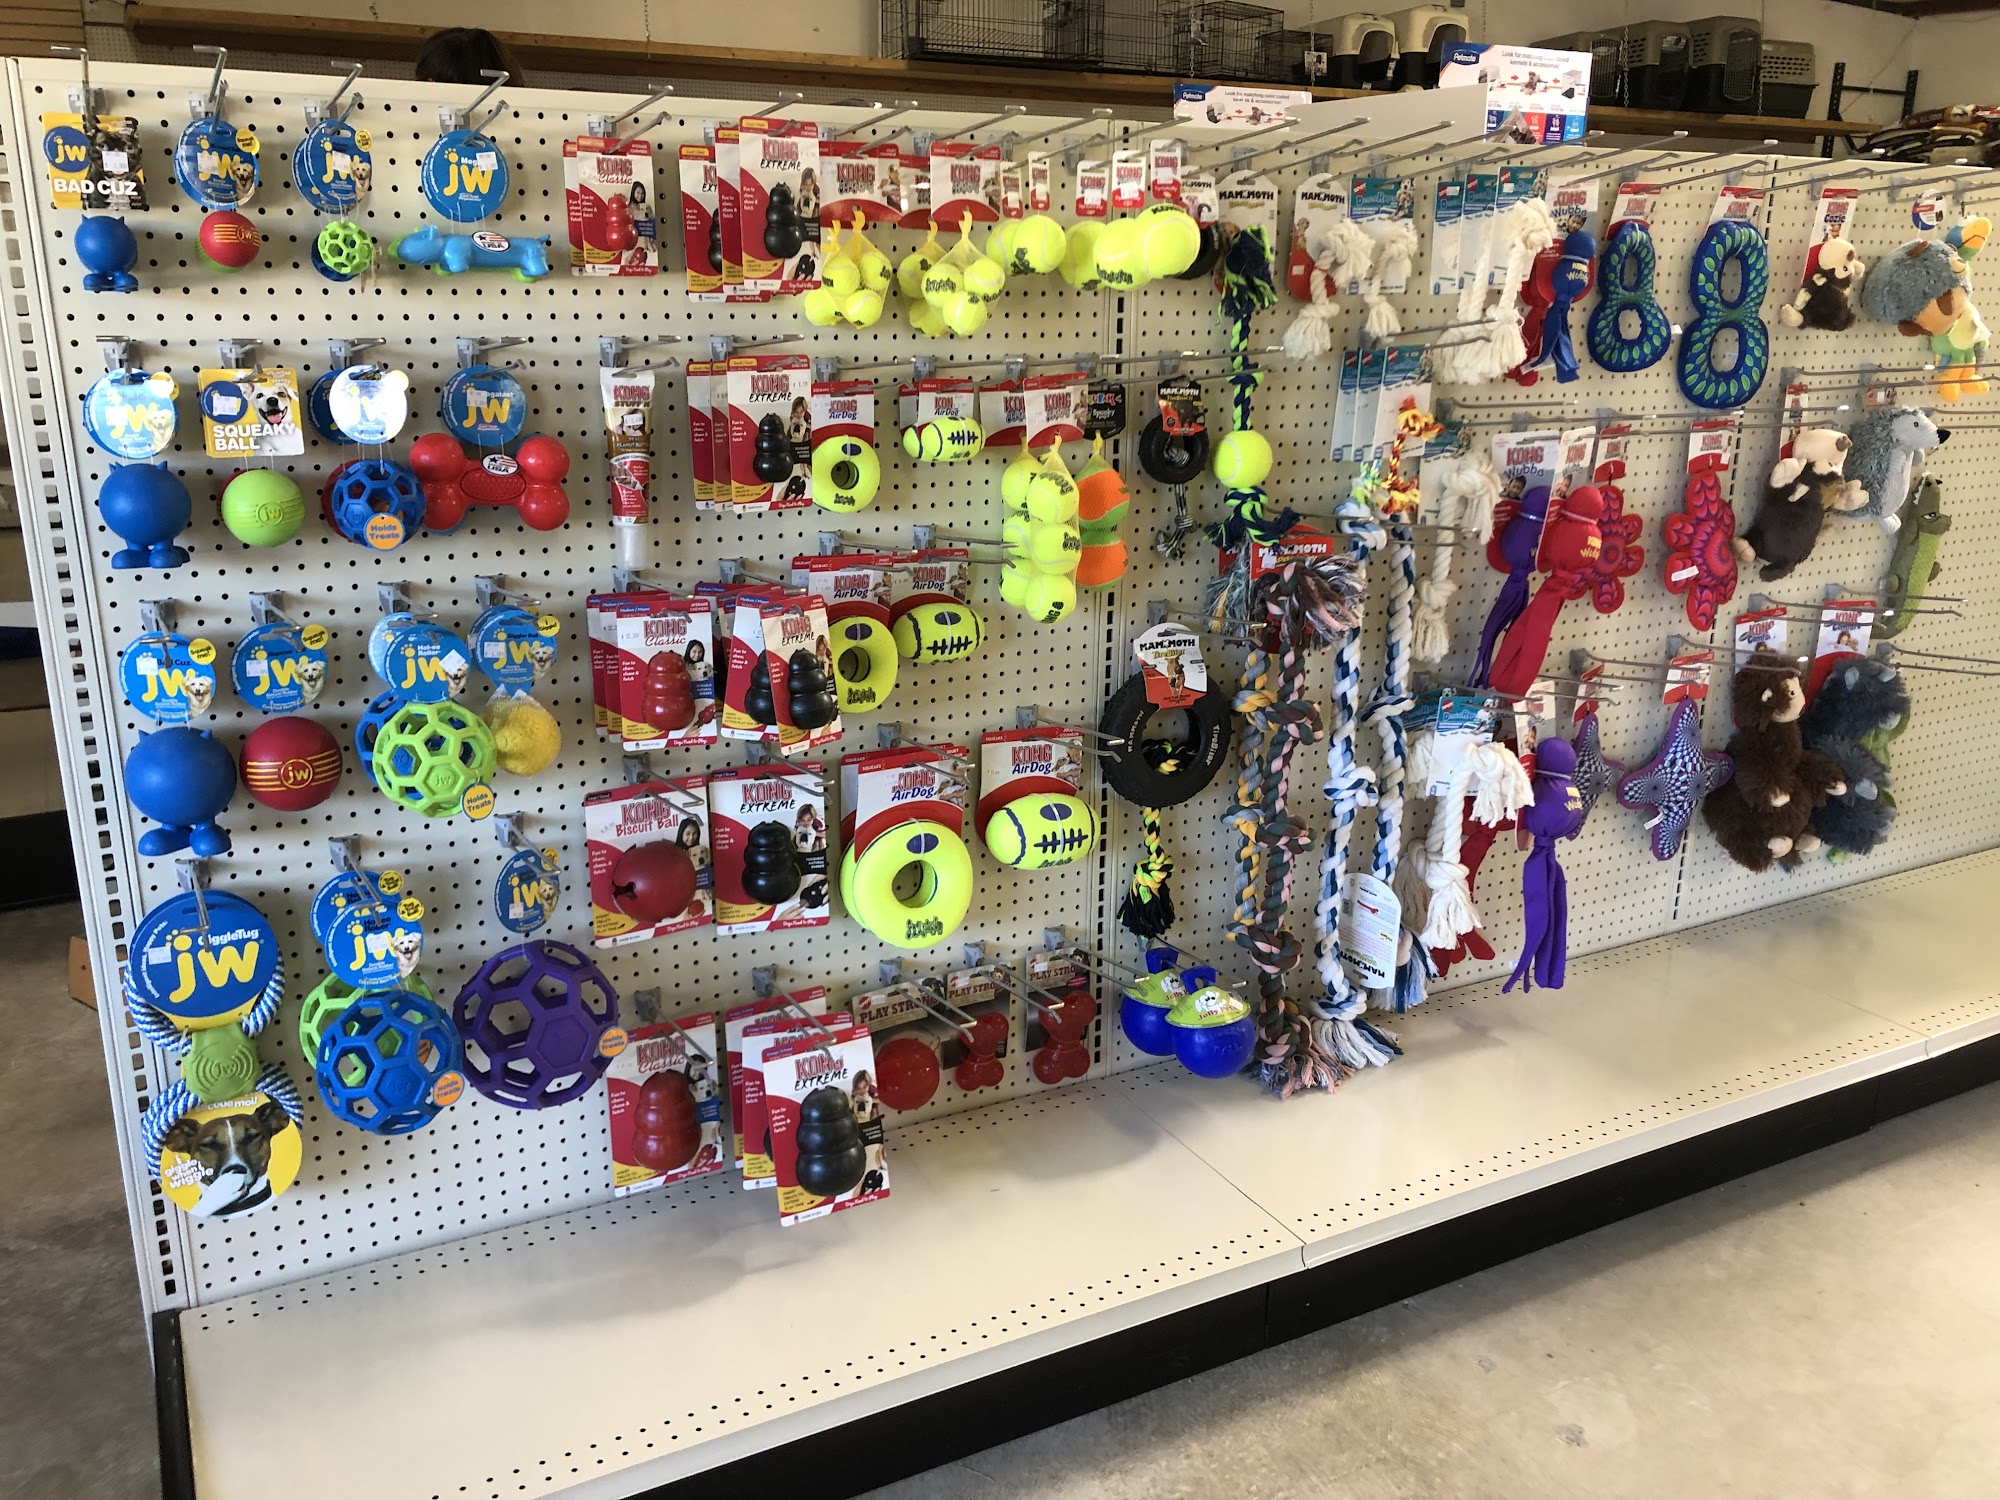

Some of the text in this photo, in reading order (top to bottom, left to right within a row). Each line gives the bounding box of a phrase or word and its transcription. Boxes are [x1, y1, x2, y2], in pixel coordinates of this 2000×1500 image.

[1453, 50, 1477, 62] Petmate
[1501, 51, 1514, 59] Look
[55, 137, 87, 163] jw
[761, 138, 800, 160] KONG
[596, 156, 634, 176] KONG
[760, 158, 801, 171] EXTREME
[1154, 155, 1179, 168] KONG
[443, 152, 493, 196] jw
[598, 173, 633, 185] Classic
[836, 163, 876, 182] KONG
[950, 163, 980, 182] KONG
[1116, 166, 1143, 180] KONG
[54, 179, 138, 196] BAD CUZ
[1080, 176, 1106, 189] KONG
[1219, 190, 1274, 200] MAMMOTH
[1301, 191, 1346, 204] MAMMOTH
[1553, 190, 1587, 206] KONG
[1551, 205, 1588, 219] Wubba
[1826, 202, 1850, 214] KONG
[1823, 213, 1847, 224] Cozie
[1566, 271, 1590, 284] Wubb
[751, 374, 790, 393] KONG
[485, 391, 514, 399] egalast
[613, 384, 651, 401] KONG
[749, 391, 793, 403] EXTREME
[1159, 387, 1200, 396] MAMMOTH
[829, 399, 858, 412] KONG
[935, 396, 954, 410] KON
[1003, 396, 1026, 412] KO
[1044, 392, 1072, 411] KONG
[828, 411, 858, 421] AirDog
[934, 407, 960, 417] AirDog
[1092, 408, 1116, 418] Spunky
[212, 423, 296, 438] SQUEAKY
[215, 437, 261, 451] BALL
[1702, 434, 1723, 447] KONG
[1506, 446, 1545, 466] KONG
[1565, 443, 1588, 465] KONG
[1504, 463, 1545, 479] Wubba
[263, 506, 282, 521] jw
[369, 531, 400, 541] Treats
[370, 525, 397, 533] Holds
[1258, 543, 1328, 558] MAMOTH
[912, 566, 947, 583] KONG
[833, 574, 871, 592] KONG
[912, 580, 946, 591] AirDog
[833, 588, 869, 599] AirDog
[643, 617, 688, 639] KONG
[780, 615, 812, 638] KONG
[1749, 620, 1775, 636] KONG
[302, 628, 327, 643] Squeak
[308, 636, 324, 647] me!
[645, 635, 687, 647] Classic
[781, 631, 815, 647] EXTREME
[1747, 633, 1776, 643] Comfo
[190, 644, 213, 656] Squeak
[417, 644, 441, 652] Hol-ee
[1139, 639, 1196, 651] MAMMOTH
[196, 651, 211, 660] me!
[417, 649, 440, 657] Roller
[174, 659, 192, 667] Cuz
[401, 647, 448, 689] jw
[1127, 709, 1145, 753] MAMMOTH
[985, 735, 1004, 743] SQUEAKS
[1205, 724, 1221, 767] TireBiter
[1011, 744, 1054, 766] KONG
[286, 766, 310, 784] jw
[1011, 762, 1052, 775] AirDog
[891, 769, 936, 793] KONG
[466, 793, 489, 805] Holds
[741, 782, 793, 803] KONG
[891, 787, 935, 802] AirDog
[467, 800, 492, 812] Treats
[621, 799, 671, 826] KONG
[740, 799, 796, 814] EXTREME
[615, 814, 679, 837] Biscuit Ball
[169, 934, 260, 1003] jw
[1029, 970, 1053, 982] PLAY
[950, 986, 971, 999] PLAY
[1165, 992, 1184, 1001] Jolly
[859, 1006, 891, 1024] PLAY
[1197, 1008, 1219, 1021] Jolly
[601, 1040, 625, 1052] Treats
[602, 1034, 624, 1045] Holds
[636, 1036, 687, 1065] KONG
[638, 1055, 685, 1074] Classic
[794, 1056, 845, 1080] KONG
[436, 1077, 459, 1093] Holds
[794, 1068, 849, 1092] EXTREME
[435, 1084, 461, 1100] Treats
[234, 1096, 258, 1107] moi!
[165, 1159, 198, 1178] giggle
[172, 1166, 198, 1181] when
[169, 1168, 214, 1189] wiggle
